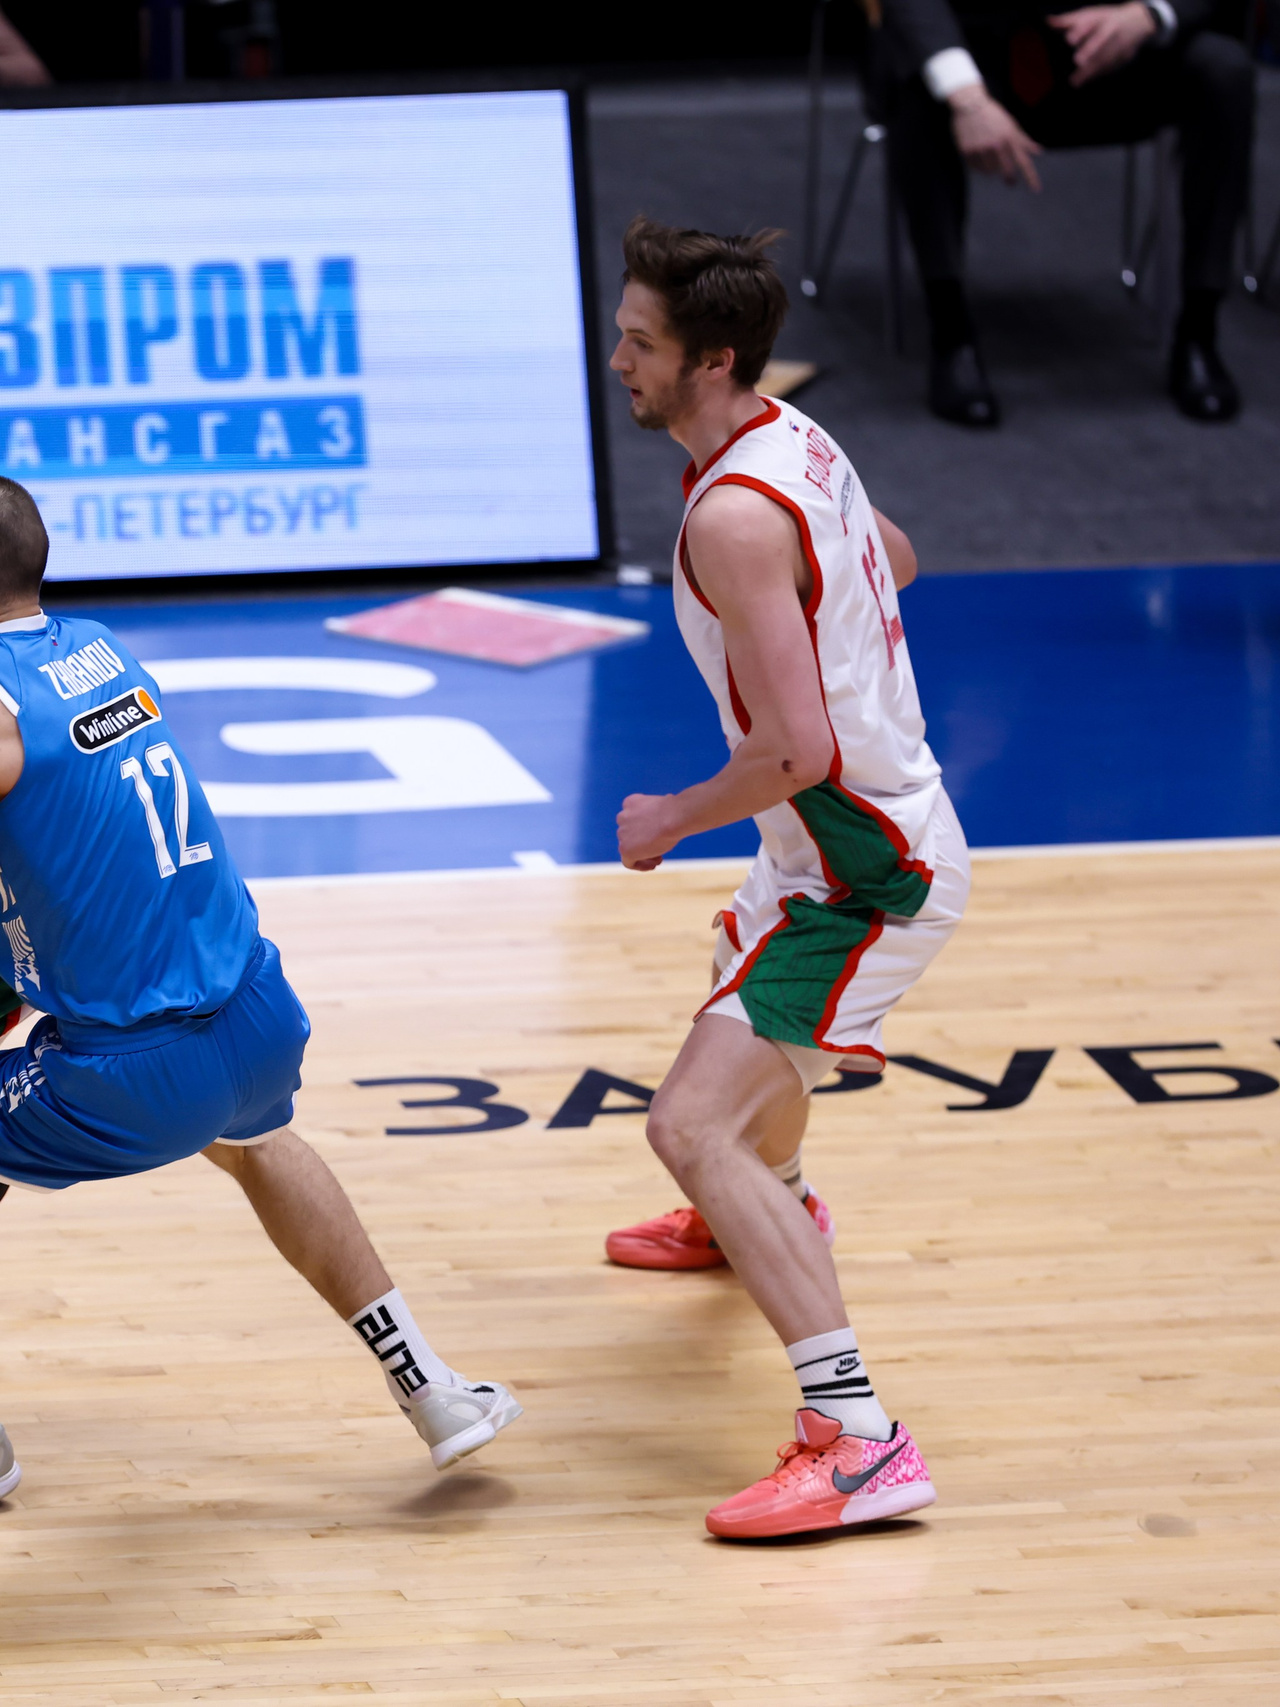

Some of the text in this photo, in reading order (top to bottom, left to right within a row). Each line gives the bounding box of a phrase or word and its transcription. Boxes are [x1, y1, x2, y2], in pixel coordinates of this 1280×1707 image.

[37, 636, 126, 700] ZHBANOV
[78, 704, 143, 743] Winline
[120, 741, 214, 879] 12
